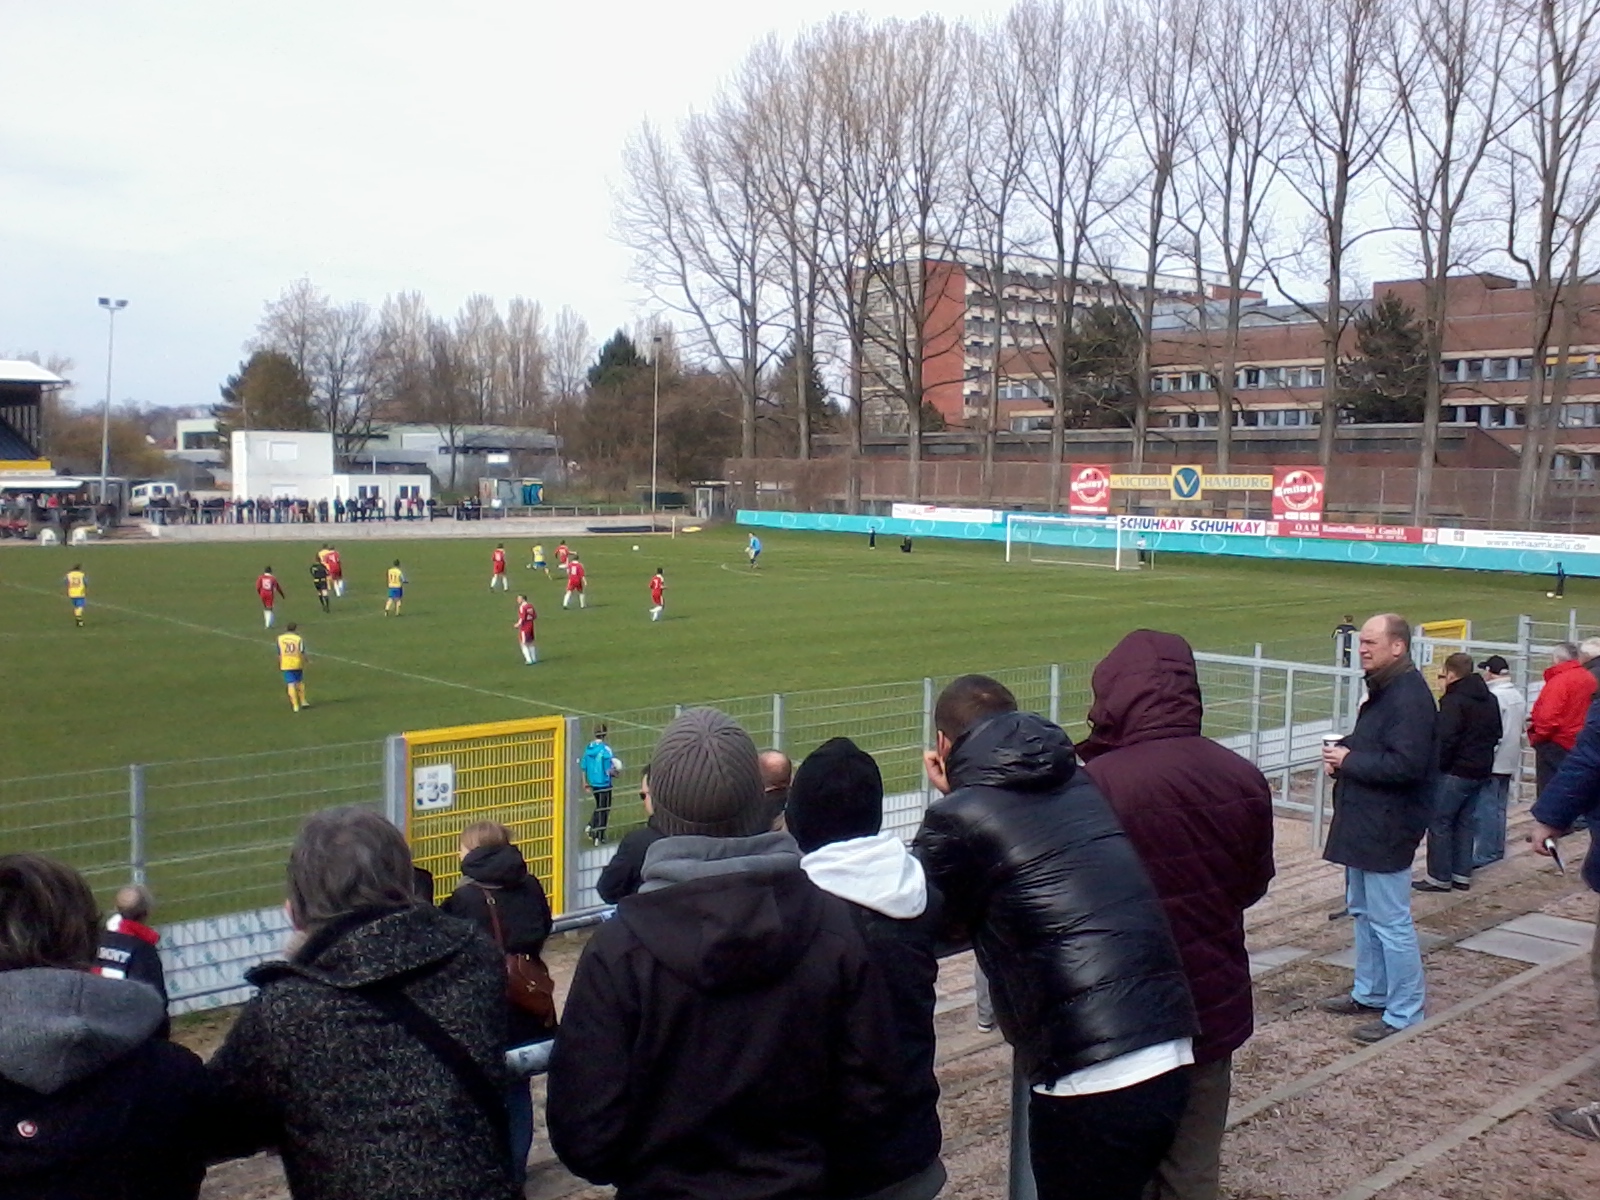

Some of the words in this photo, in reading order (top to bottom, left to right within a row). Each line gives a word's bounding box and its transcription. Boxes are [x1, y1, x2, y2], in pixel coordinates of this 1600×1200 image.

[1120, 477, 1169, 487] VICTORIA
[1204, 476, 1270, 487] HAMBURG
[1120, 517, 1185, 530] SCHUHKAY
[1190, 519, 1261, 534] SCHUHKAY
[283, 642, 296, 654] 20
